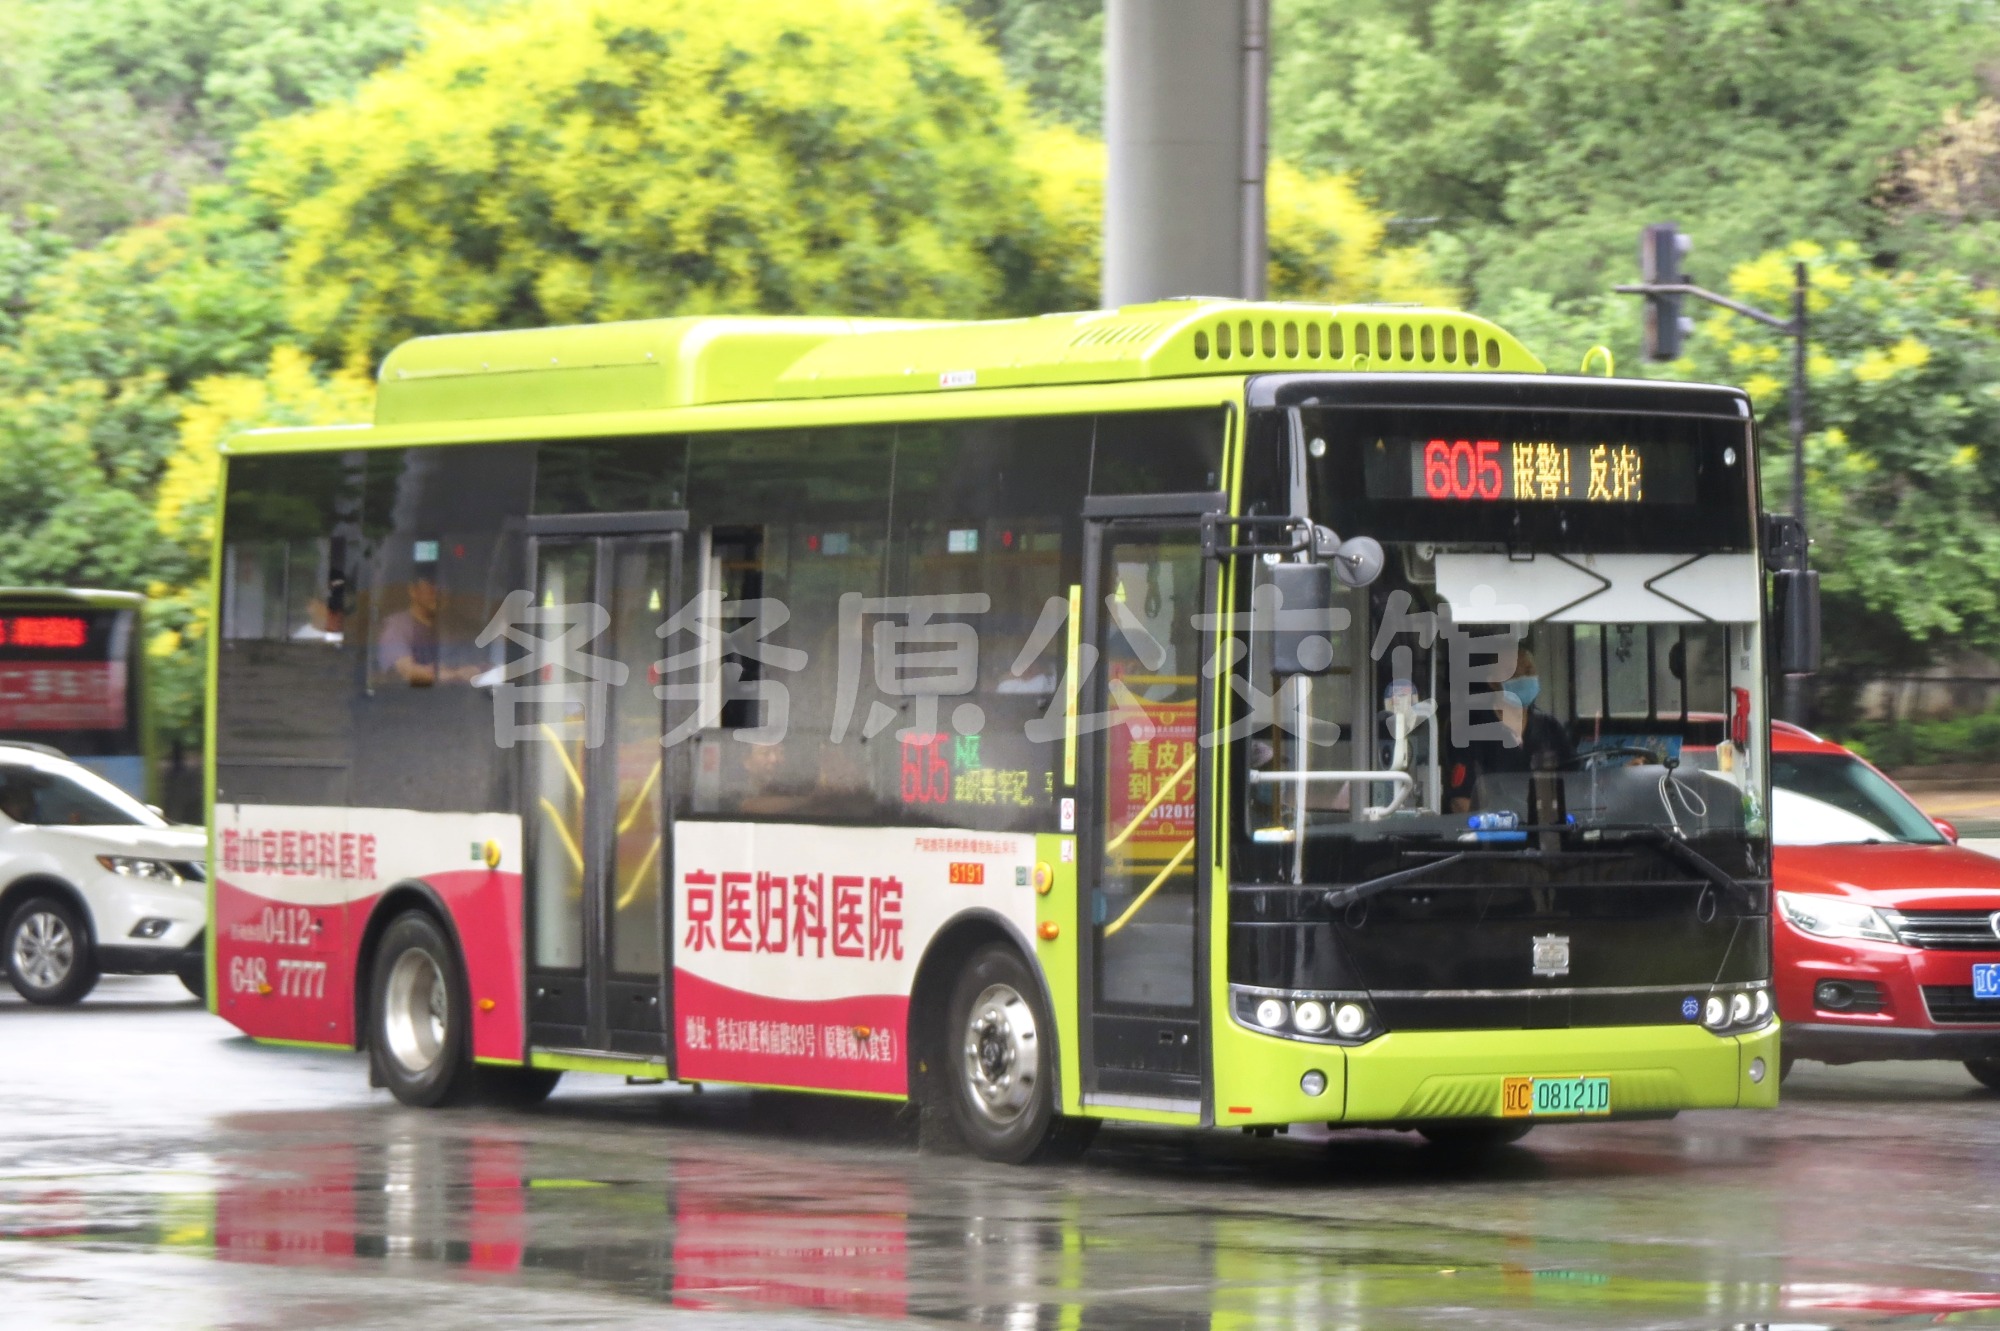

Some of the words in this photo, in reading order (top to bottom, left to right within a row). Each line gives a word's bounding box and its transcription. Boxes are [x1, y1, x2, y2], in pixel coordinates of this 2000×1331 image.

[1424, 440, 1503, 500] 605
[1587, 443, 1642, 502] 反诈
[901, 732, 950, 804] 605
[951, 863, 982, 883] 3191
[684, 868, 905, 962] 京医妇科医院
